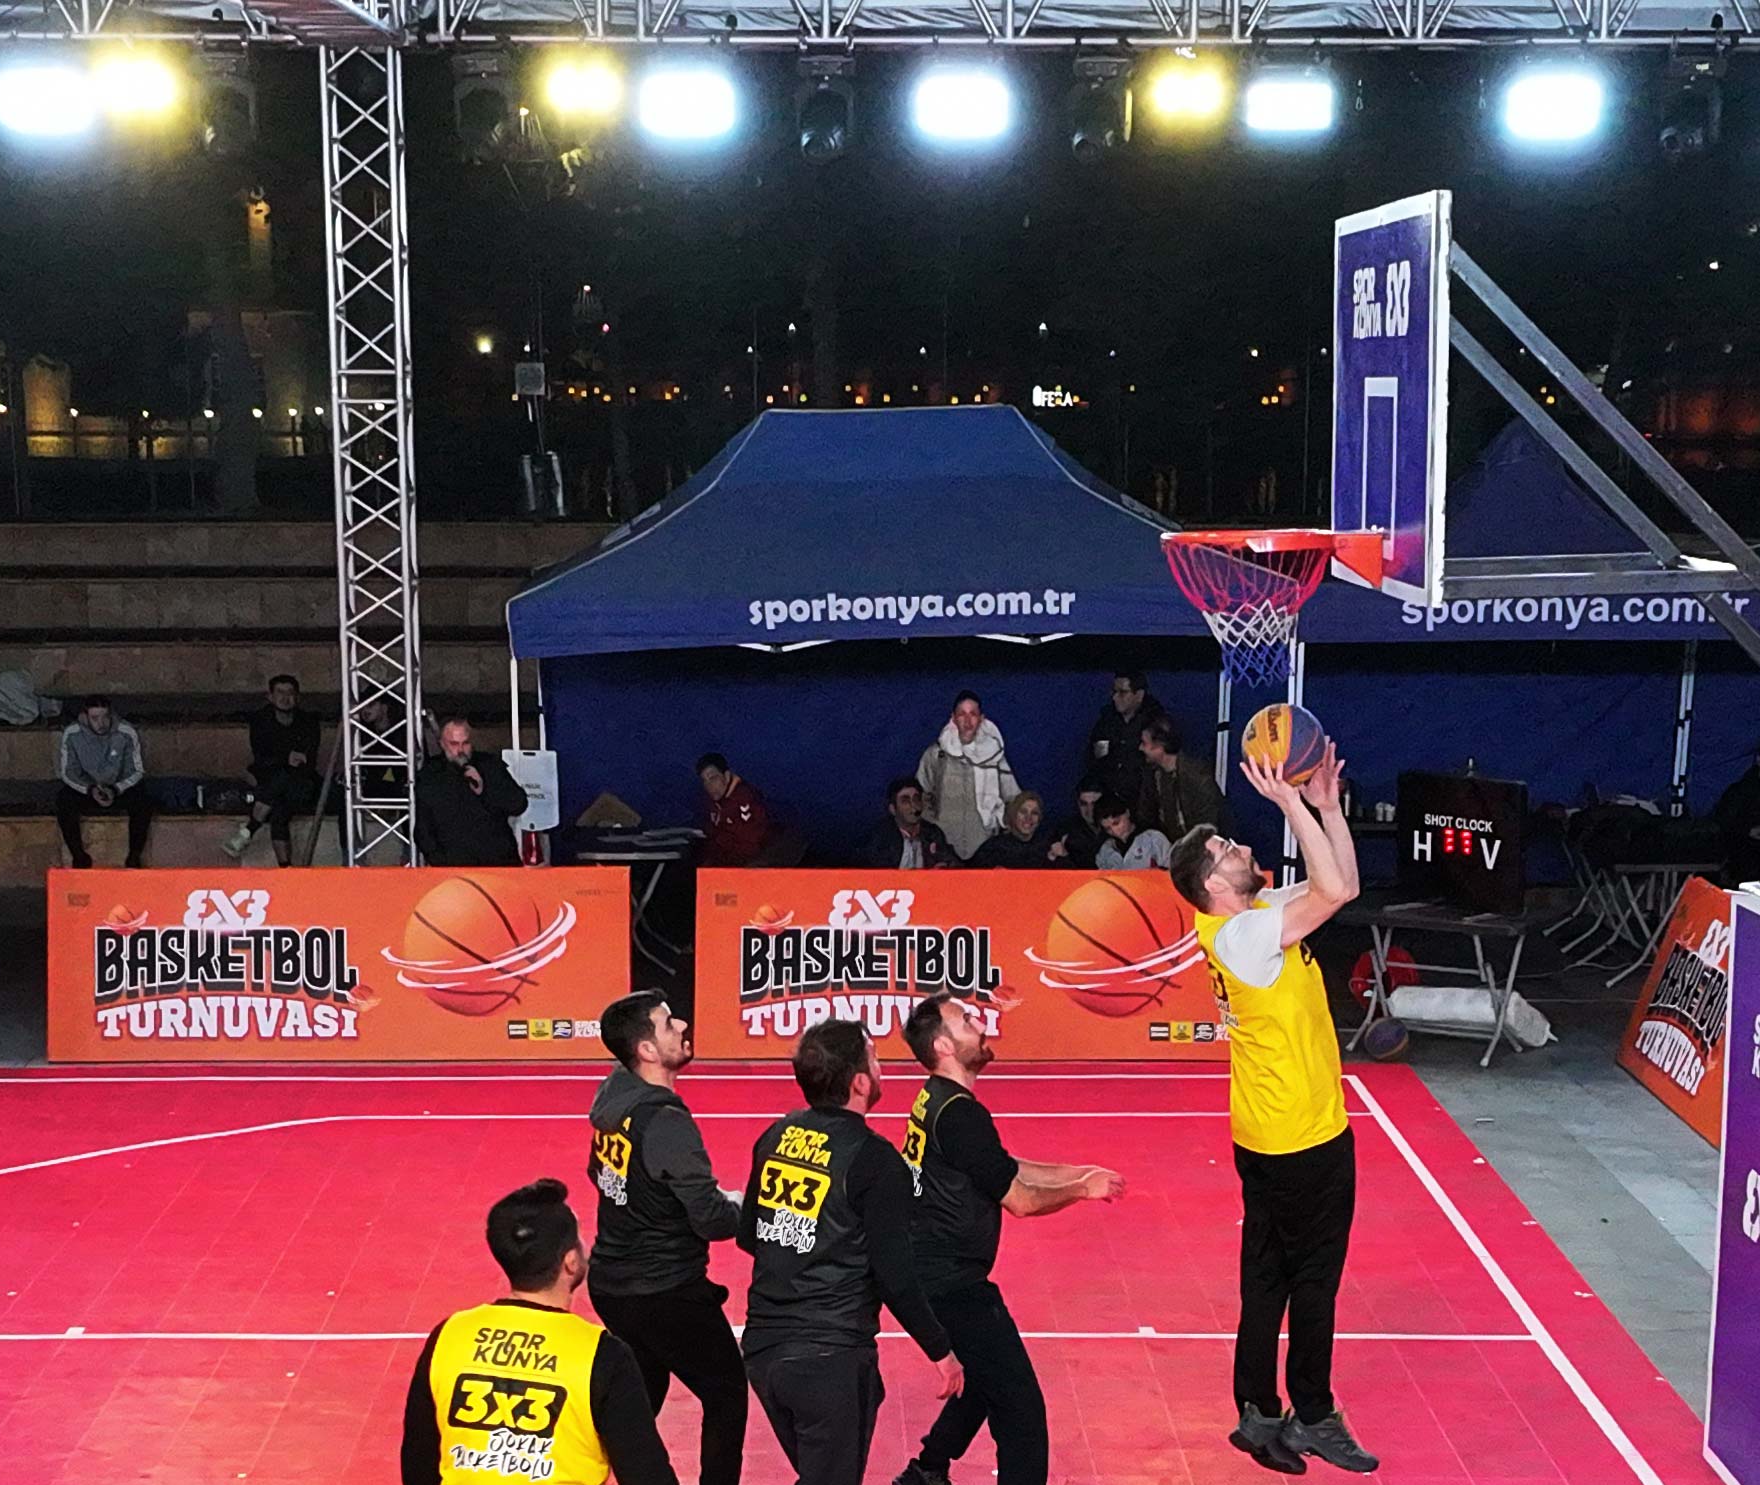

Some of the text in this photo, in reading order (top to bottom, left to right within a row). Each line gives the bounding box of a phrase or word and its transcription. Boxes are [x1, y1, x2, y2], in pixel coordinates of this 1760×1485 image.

[748, 589, 1076, 629] sporkonya.com.tr
[1424, 813, 1493, 833] SHOT CLOCK
[1413, 830, 1432, 862] H
[1480, 838, 1501, 870] V
[95, 926, 359, 1000] BASKETBOL
[740, 925, 1002, 996] BASKETBOL
[97, 996, 359, 1038] TURNUVASI
[1635, 1020, 1705, 1097] TURNUVASI
[775, 1138, 832, 1167] KONYA
[781, 1125, 828, 1148] SPOR
[761, 1166, 822, 1212] 3x3
[474, 1327, 546, 1350] SPOR
[472, 1342, 559, 1373] KONYA
[454, 1379, 556, 1433] 3x3
[490, 1430, 553, 1453] SOKAK
